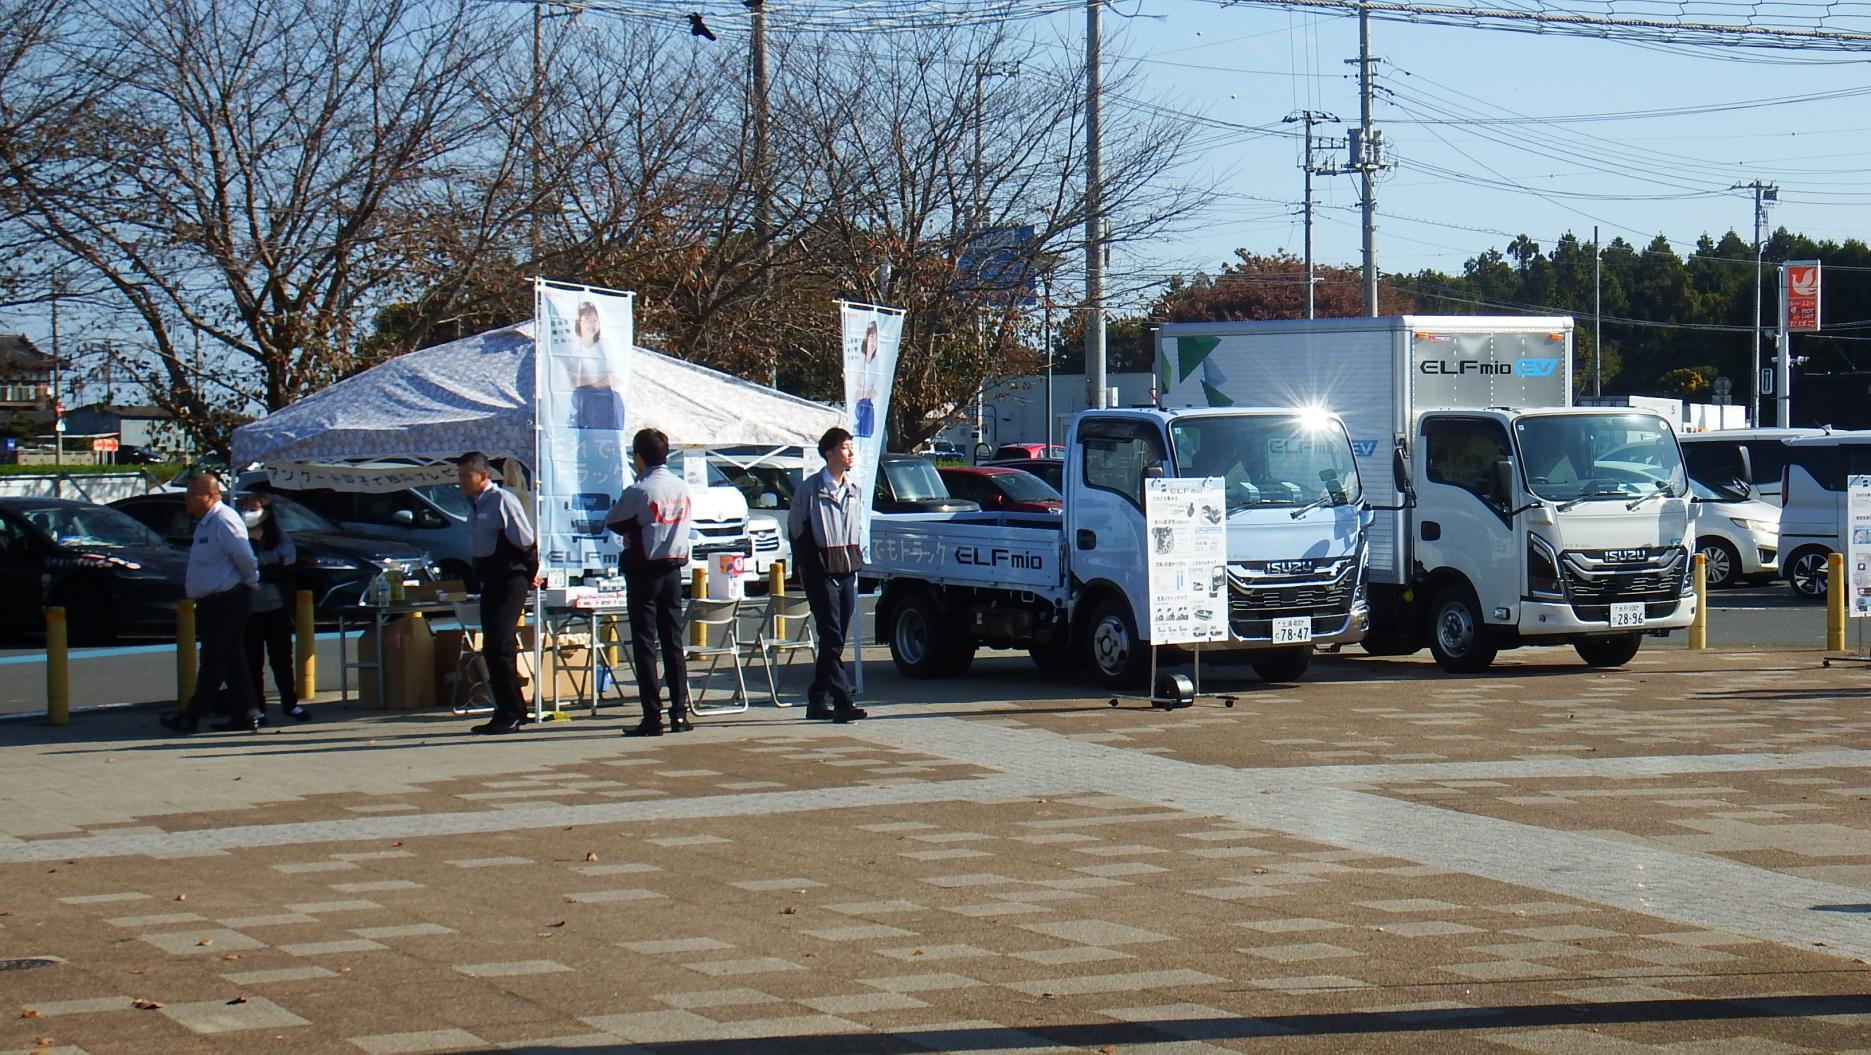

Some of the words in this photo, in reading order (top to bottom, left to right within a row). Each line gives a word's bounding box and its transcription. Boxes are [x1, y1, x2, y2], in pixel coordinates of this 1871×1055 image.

[1420, 360, 1512, 375] ELFmio
[1518, 359, 1554, 375] EV
[954, 546, 1043, 570] ELFmio
[1605, 549, 1647, 562] ISUZU
[1266, 561, 1313, 574] ISUZU
[1618, 612, 1643, 625] 28-96
[1281, 627, 1309, 641] 78-47
